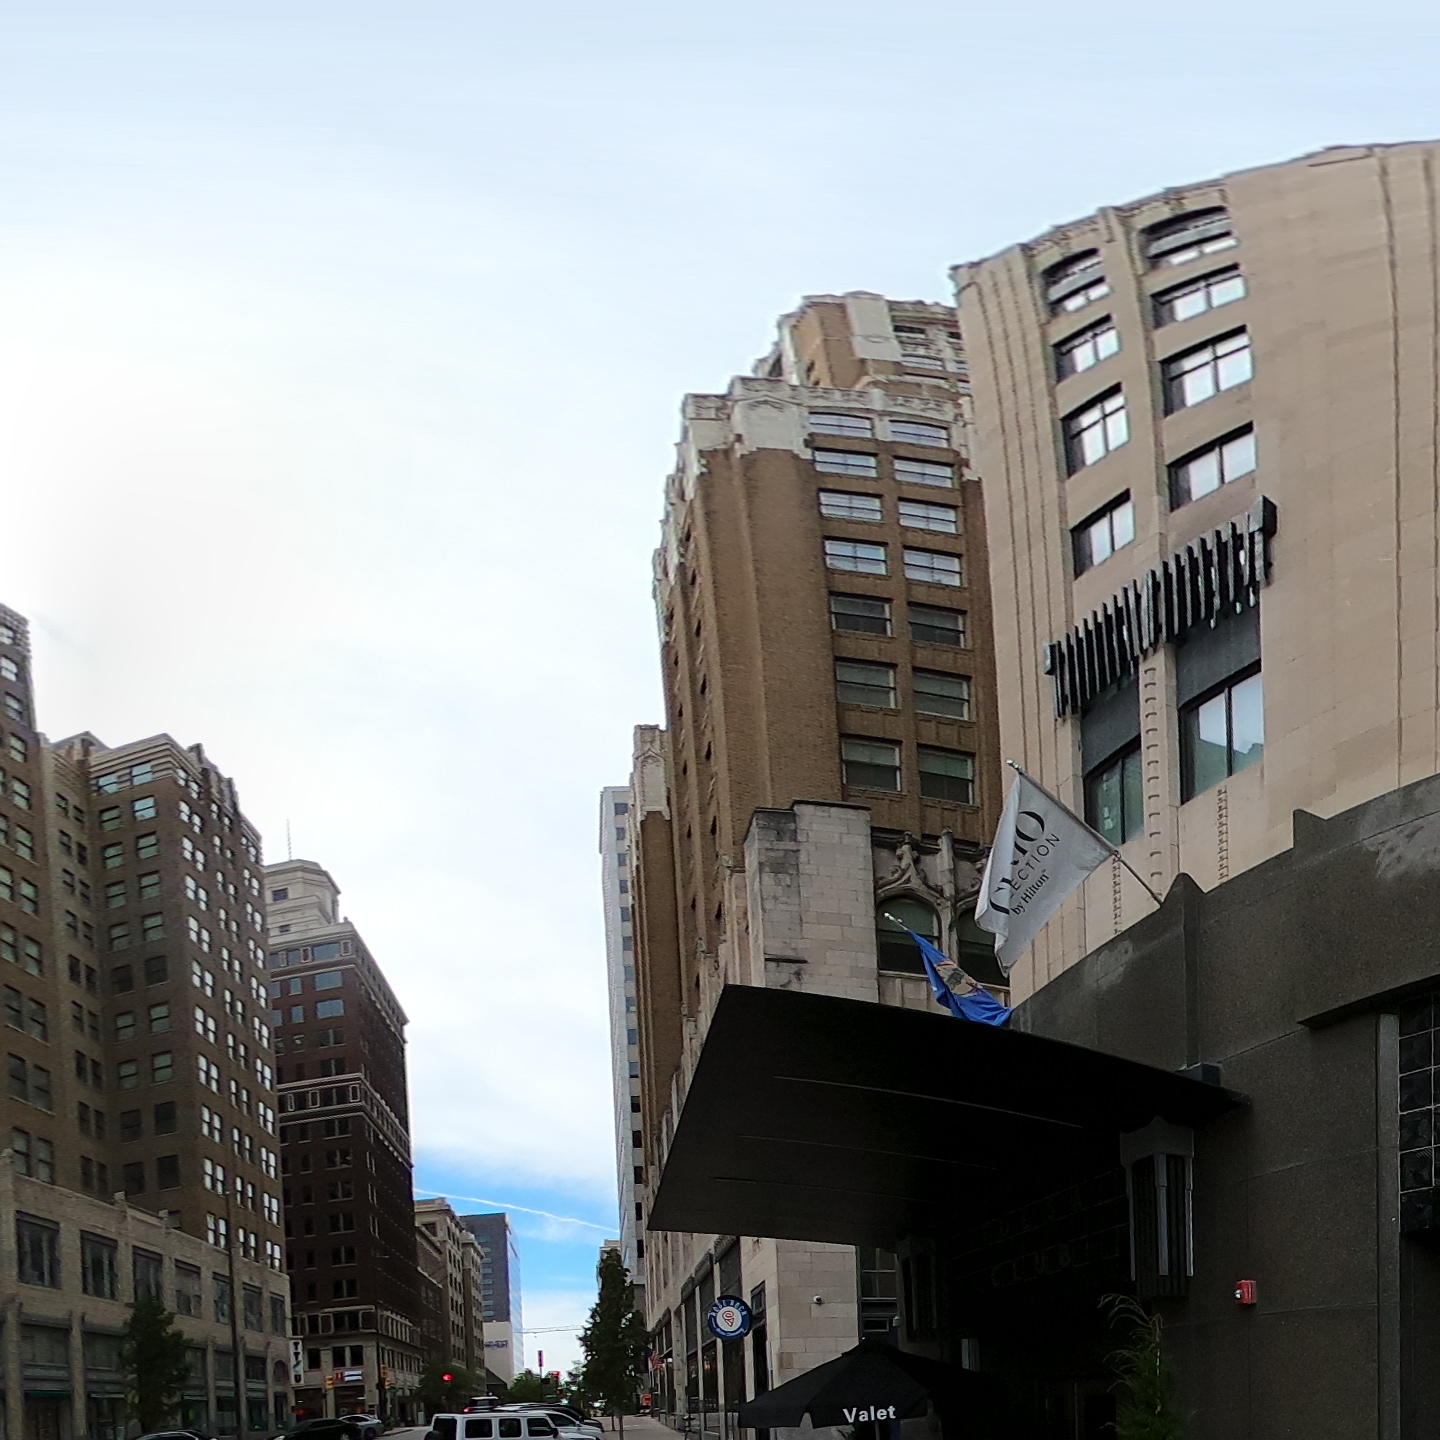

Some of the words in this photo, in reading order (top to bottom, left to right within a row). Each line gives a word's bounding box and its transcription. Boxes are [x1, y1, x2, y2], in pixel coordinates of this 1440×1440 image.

[1010, 902, 1026, 915] by
[1020, 874, 1049, 904] Hilton
[842, 1405, 897, 1424] Valet
